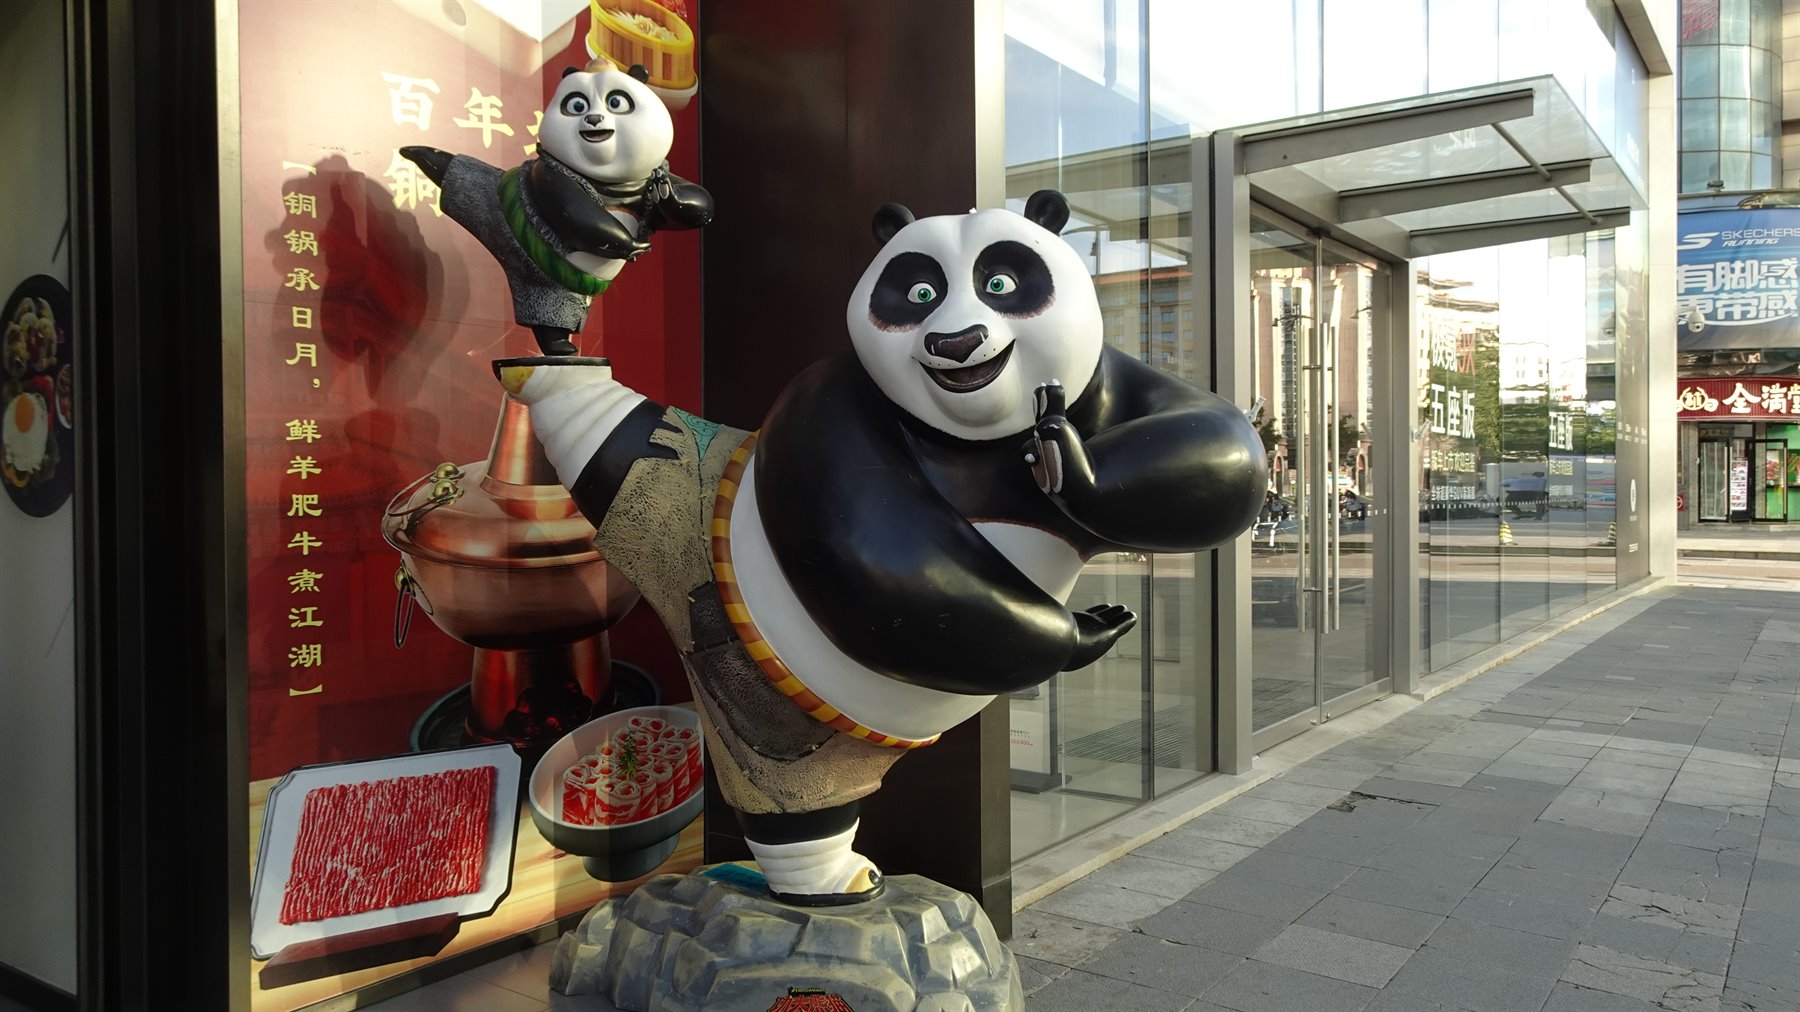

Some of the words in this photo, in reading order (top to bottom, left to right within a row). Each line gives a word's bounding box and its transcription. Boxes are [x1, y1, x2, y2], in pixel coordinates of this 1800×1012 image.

[1721, 227, 1800, 240] SKECHERS
[1722, 237, 1778, 247] RUNNING
[1677, 257, 1798, 293] 有脚感
[1431, 383, 1475, 439] 五座版
